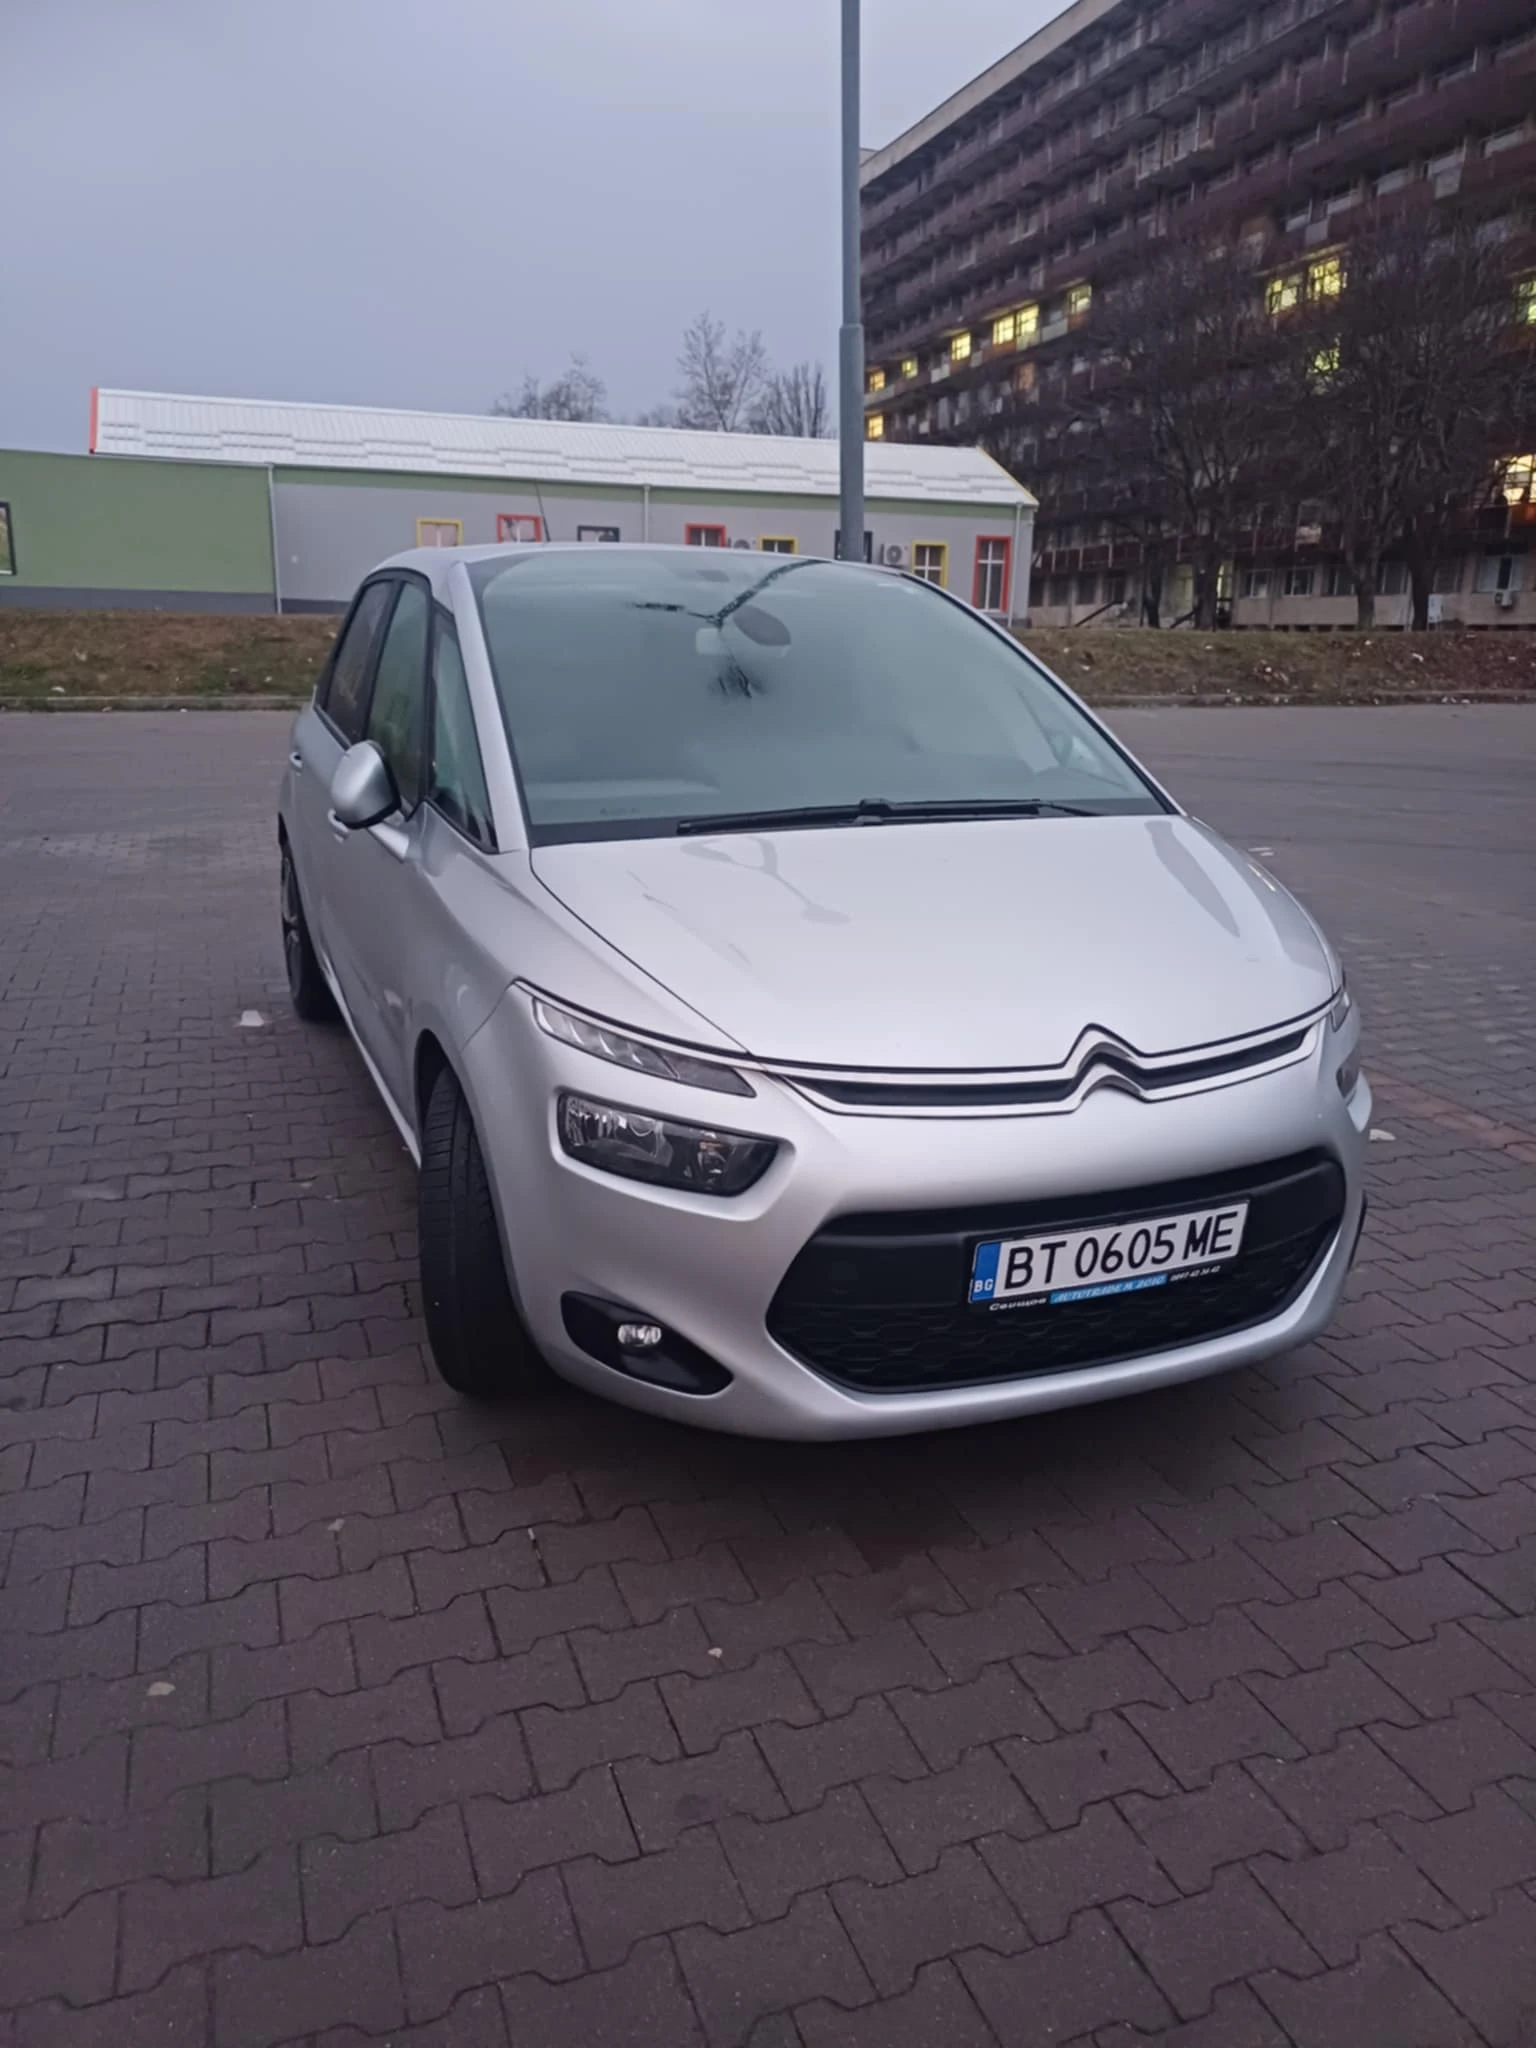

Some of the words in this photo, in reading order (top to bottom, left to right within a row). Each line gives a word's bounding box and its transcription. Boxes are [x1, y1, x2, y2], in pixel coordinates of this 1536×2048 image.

[1004, 1240, 1067, 1290] BT
[1074, 1222, 1177, 1279] 0605
[1182, 1211, 1239, 1260] ME
[973, 1278, 993, 1293] BG
